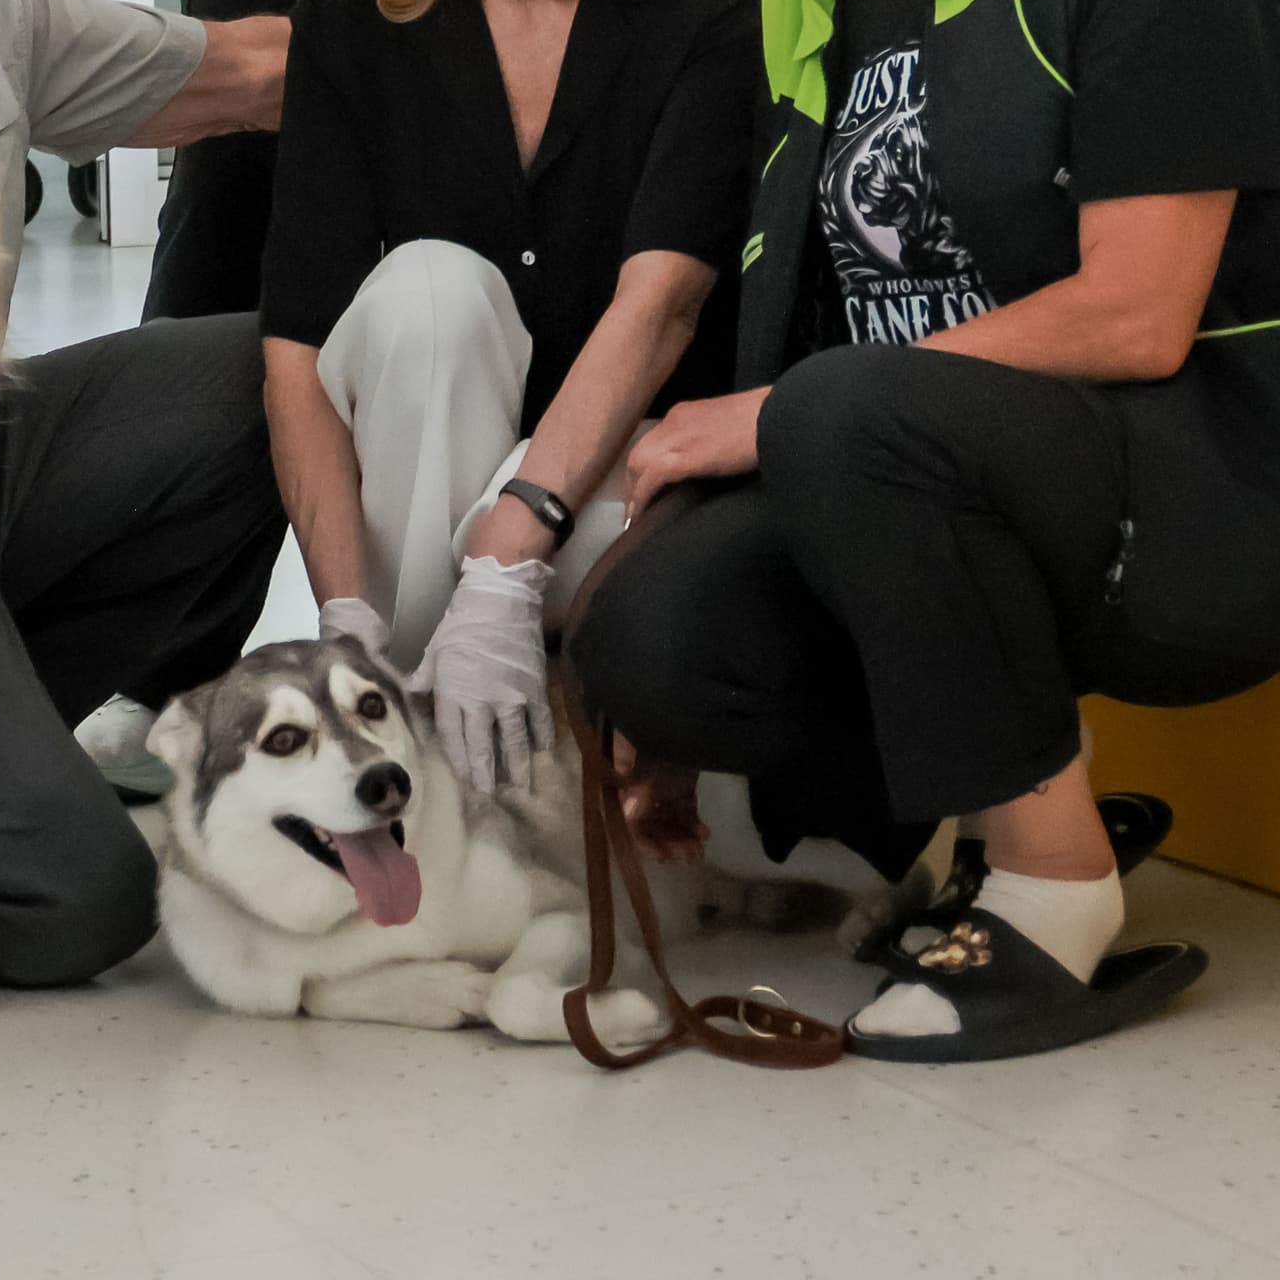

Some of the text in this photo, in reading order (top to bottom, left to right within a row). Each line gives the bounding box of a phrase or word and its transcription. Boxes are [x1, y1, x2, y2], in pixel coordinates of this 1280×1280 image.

[836, 48, 920, 130] JUST
[868, 274, 971, 295] WHO LOVES
[943, 287, 998, 329] CO
